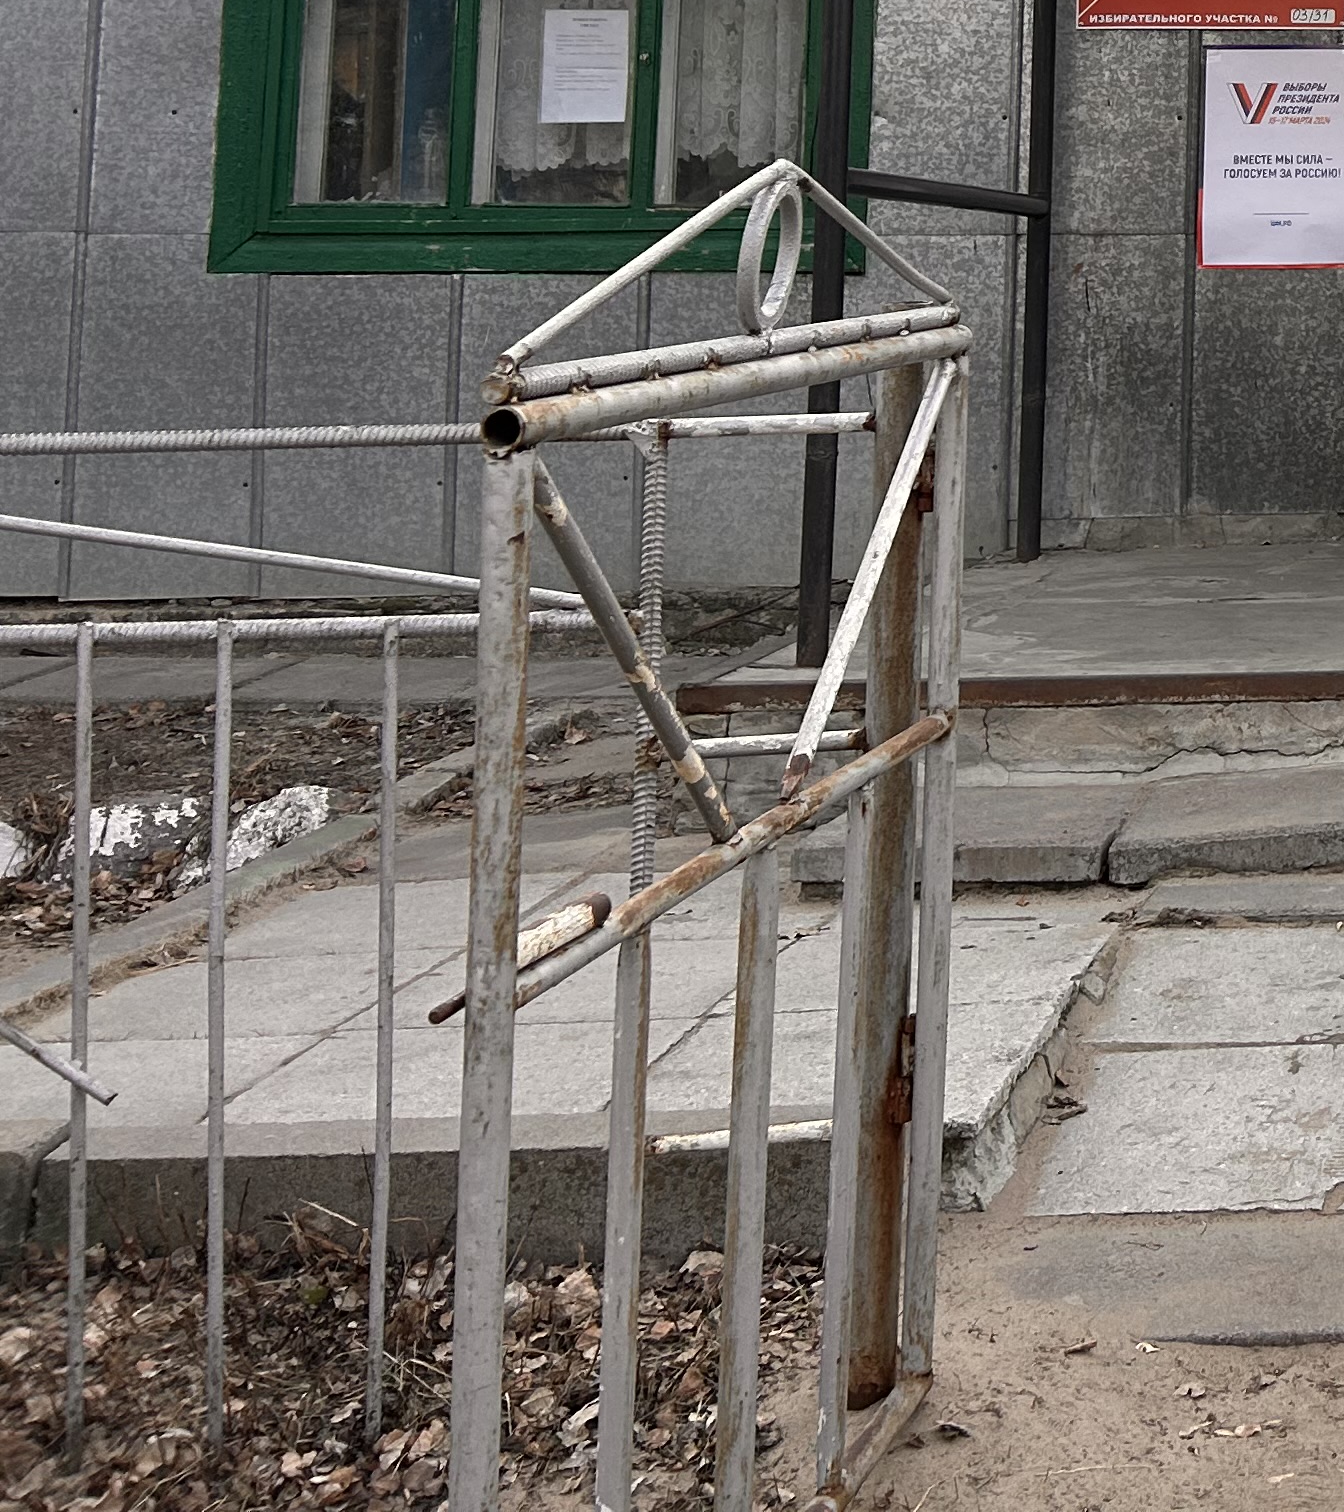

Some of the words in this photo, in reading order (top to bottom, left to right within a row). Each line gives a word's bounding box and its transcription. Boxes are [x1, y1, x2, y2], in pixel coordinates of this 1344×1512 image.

[1089, 13, 1202, 24] ИЗБИРАТЕЛЬНОГО
[1205, 14, 1261, 25] УЧАСТКА
[1282, 82, 1328, 92] ВЫБОРЫ
[1277, 94, 1340, 105] ПРЕЗИДЕНТА
[1271, 105, 1314, 115] РОССИИ
[1232, 154, 1273, 165] ВМЕСТЕ
[1275, 154, 1294, 165] МЫ
[1296, 154, 1324, 165] СИЛА
[1223, 168, 1277, 179] ГОЛОСУЕМ
[1279, 168, 1293, 179] ЗА
[1294, 167, 1342, 179] РОССИЮ!
